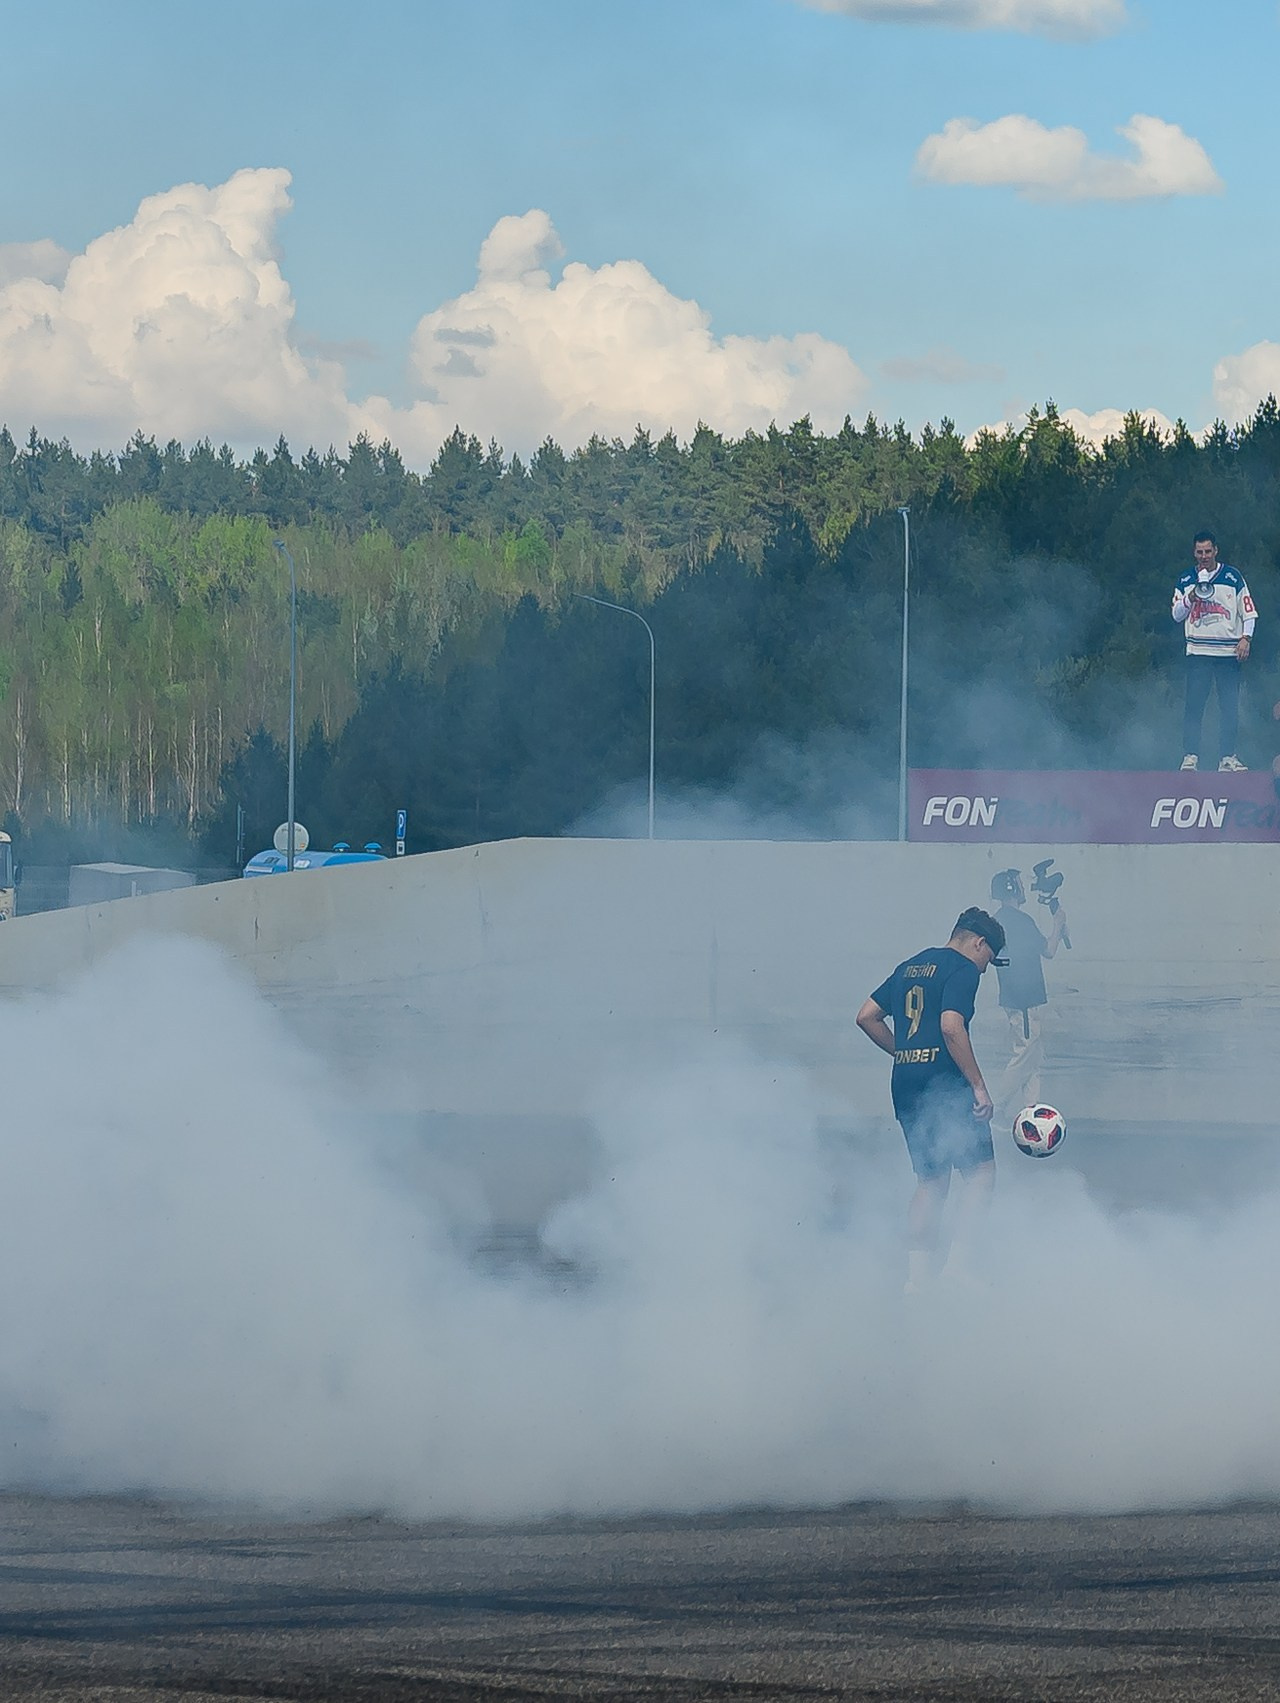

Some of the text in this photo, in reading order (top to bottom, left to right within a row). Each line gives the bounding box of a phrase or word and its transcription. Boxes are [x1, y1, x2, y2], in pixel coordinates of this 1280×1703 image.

[922, 796, 999, 826] FON
[1150, 798, 1229, 828] FON
[905, 984, 924, 1040] 9
[895, 1047, 939, 1065] ONBET
